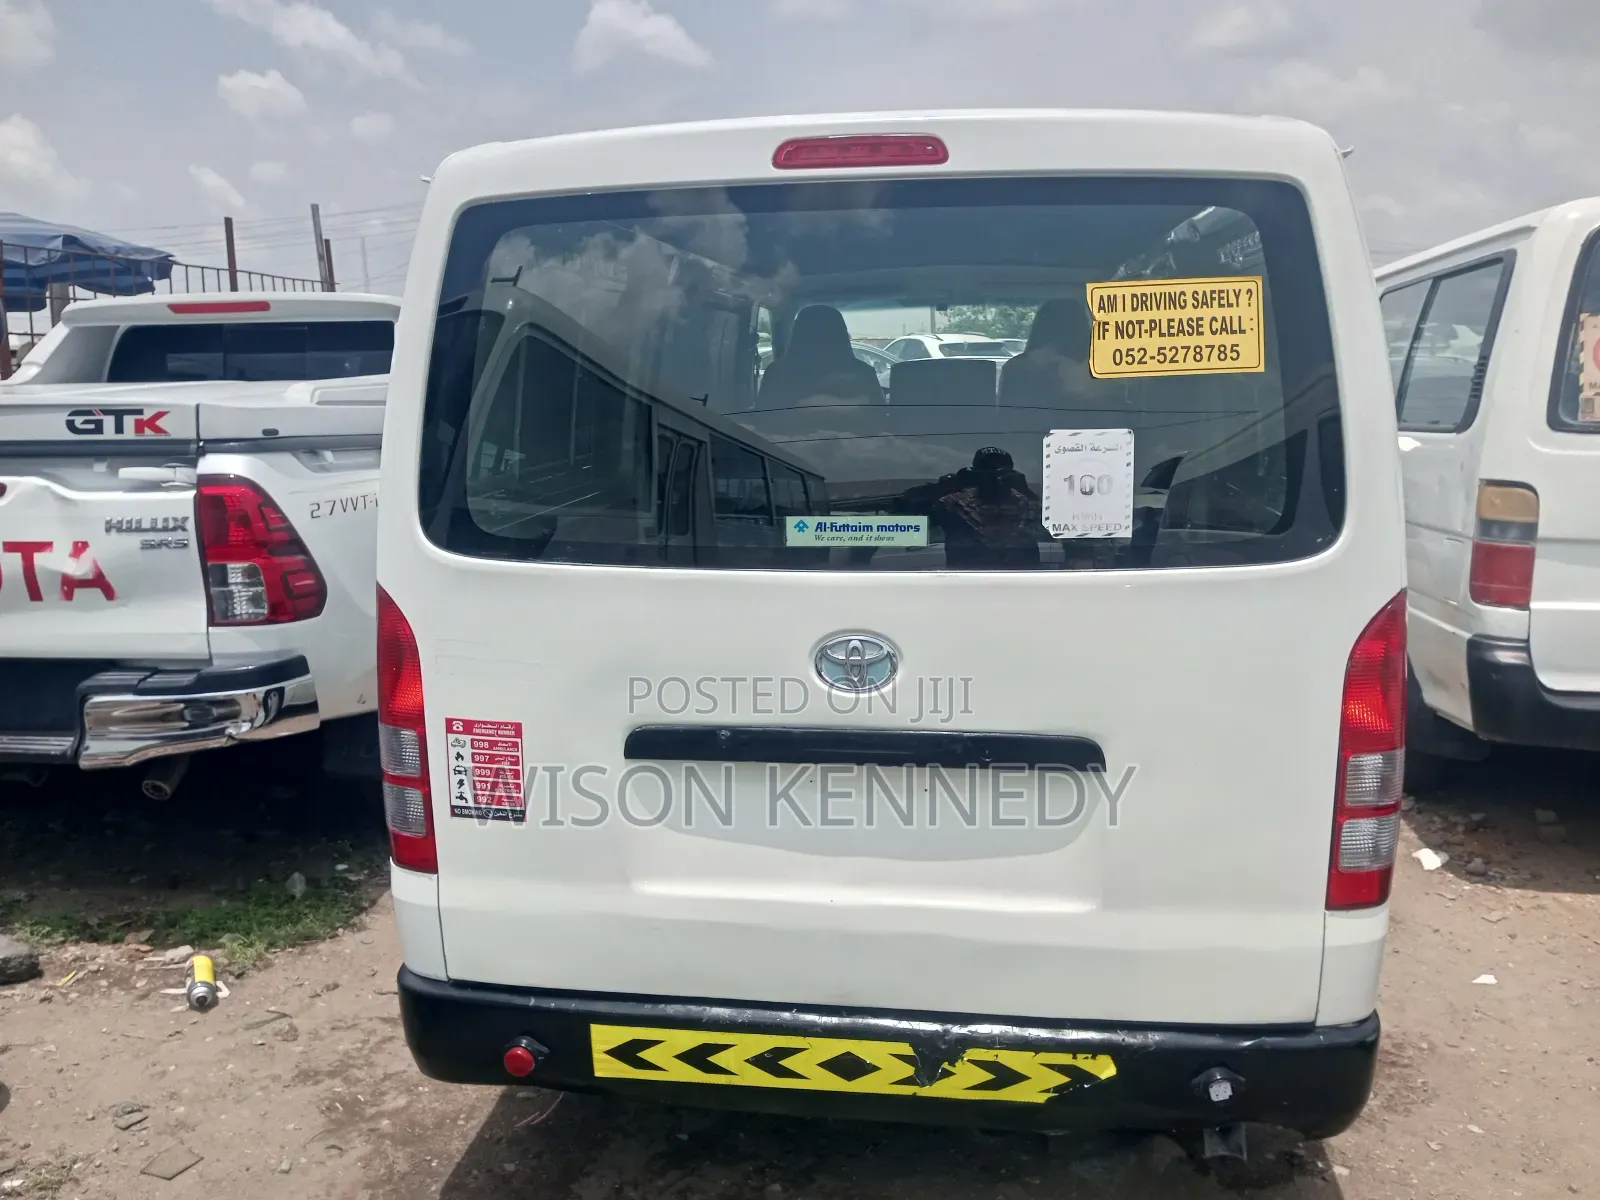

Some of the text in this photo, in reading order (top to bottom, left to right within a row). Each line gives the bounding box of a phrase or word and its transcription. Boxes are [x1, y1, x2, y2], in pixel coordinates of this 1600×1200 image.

[1097, 294, 1117, 313] AM
[1122, 293, 1126, 312] I
[1131, 290, 1187, 312] DRIVING
[1191, 288, 1242, 309] SAFELY
[1097, 320, 1110, 340] IF
[1114, 316, 1204, 340] NOT-PLEASE
[1209, 315, 1246, 335] CALL
[1112, 344, 1240, 366] 052-5278785
[65, 408, 172, 436] GTK
[1090, 442, 1122, 454] السرعة
[1063, 474, 1113, 496] 100
[104, 516, 190, 533] HILUX
[814, 521, 921, 533] Al-Futtaim motors
[1052, 523, 1122, 532] MAX SPEED
[814, 534, 825, 542] We
[848, 534, 864, 542] and
[865, 534, 873, 542] it
[874, 534, 895, 542] shows
[472, 728, 498, 736] EMERGENCY
[473, 740, 489, 749] 998
[474, 754, 490, 762] 997
[475, 768, 491, 776] 999
[475, 782, 491, 790] 991
[476, 795, 492, 804] 992
[462, 808, 483, 816] SMOKING
